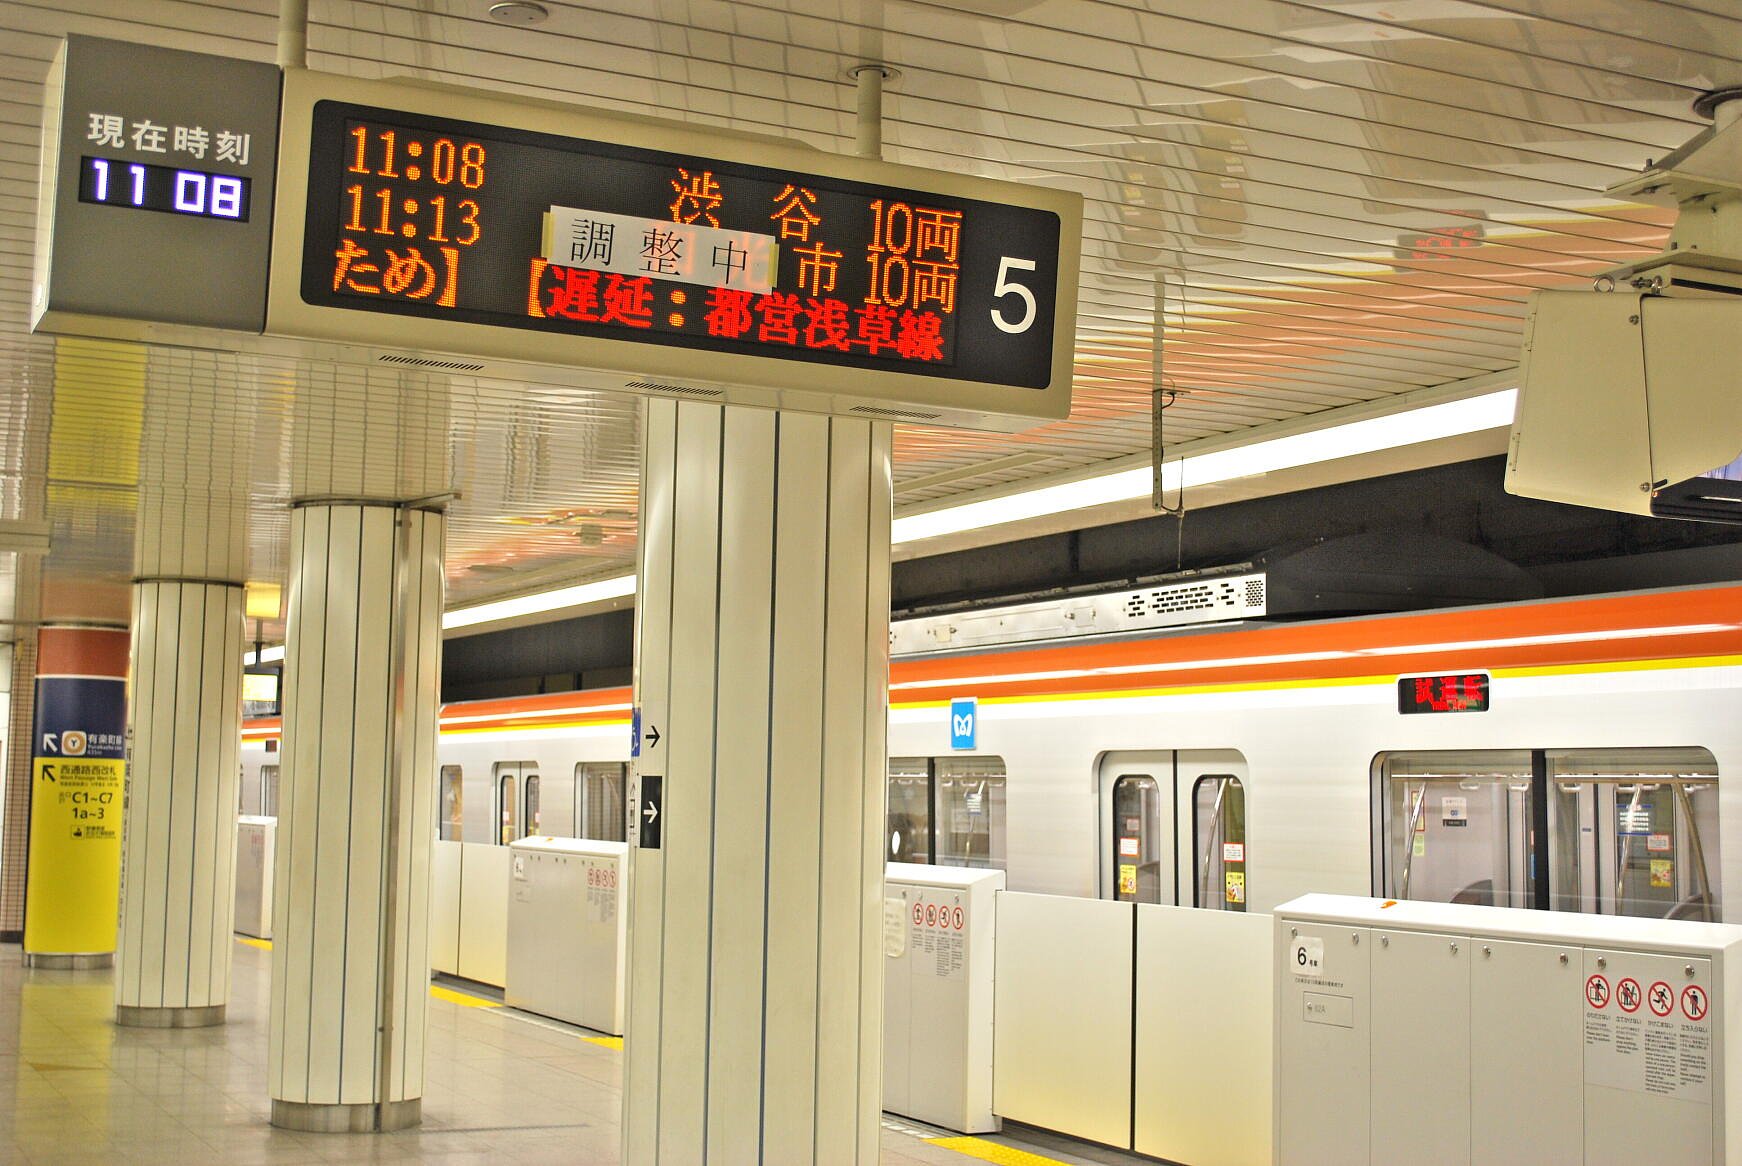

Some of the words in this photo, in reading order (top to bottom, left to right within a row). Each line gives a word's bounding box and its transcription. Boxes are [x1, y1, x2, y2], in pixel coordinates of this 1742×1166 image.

[88, 114, 251, 166] 現在時刻
[348, 126, 486, 189] 11:08
[868, 199, 963, 263] 10両
[344, 185, 481, 245] 11:13
[864, 252, 959, 313] 10両
[570, 217, 748, 285] 調整中
[990, 256, 1037, 335] 5
[1297, 946, 1307, 966] 6
